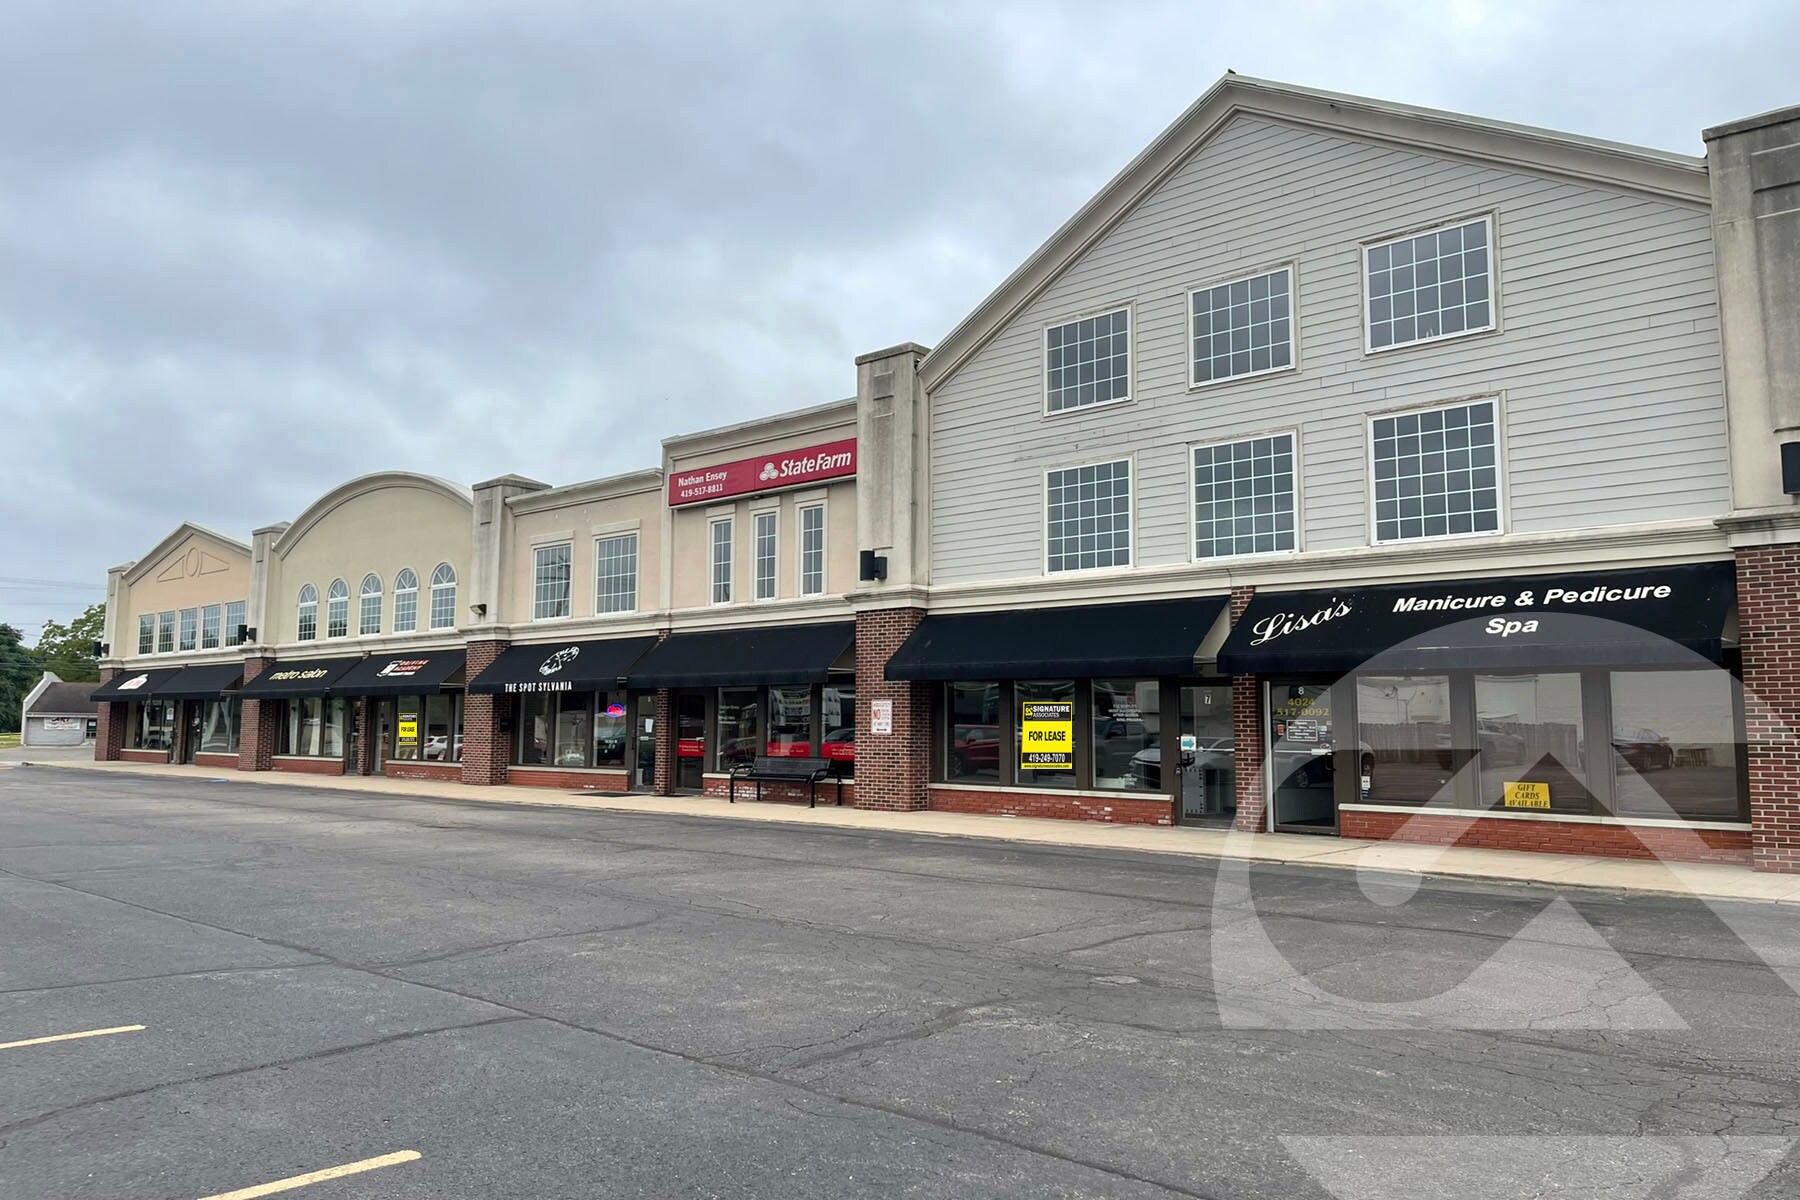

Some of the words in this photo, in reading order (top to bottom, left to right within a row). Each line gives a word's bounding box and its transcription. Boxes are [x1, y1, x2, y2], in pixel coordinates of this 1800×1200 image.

[678, 475, 704, 488] Nathan
[705, 470, 728, 482] Ensey
[680, 483, 724, 499] 419-517-8811
[1392, 595, 1507, 613] Manicure
[1514, 590, 1534, 607] &
[1543, 585, 1672, 605] Pedicure
[1250, 597, 1352, 646] Lisa's
[1485, 617, 1539, 638] Spa
[269, 670, 301, 681] metro
[301, 668, 328, 679] salon
[504, 683, 517, 693] THE
[518, 682, 536, 692] SPOT
[537, 680, 572, 692] SYLVANIA
[1297, 686, 1305, 695] 8
[1204, 694, 1212, 705] 7
[1029, 731, 1042, 741] FOR
[1044, 731, 1065, 741] LEASE
[1029, 754, 1065, 762] 419-249-7070
